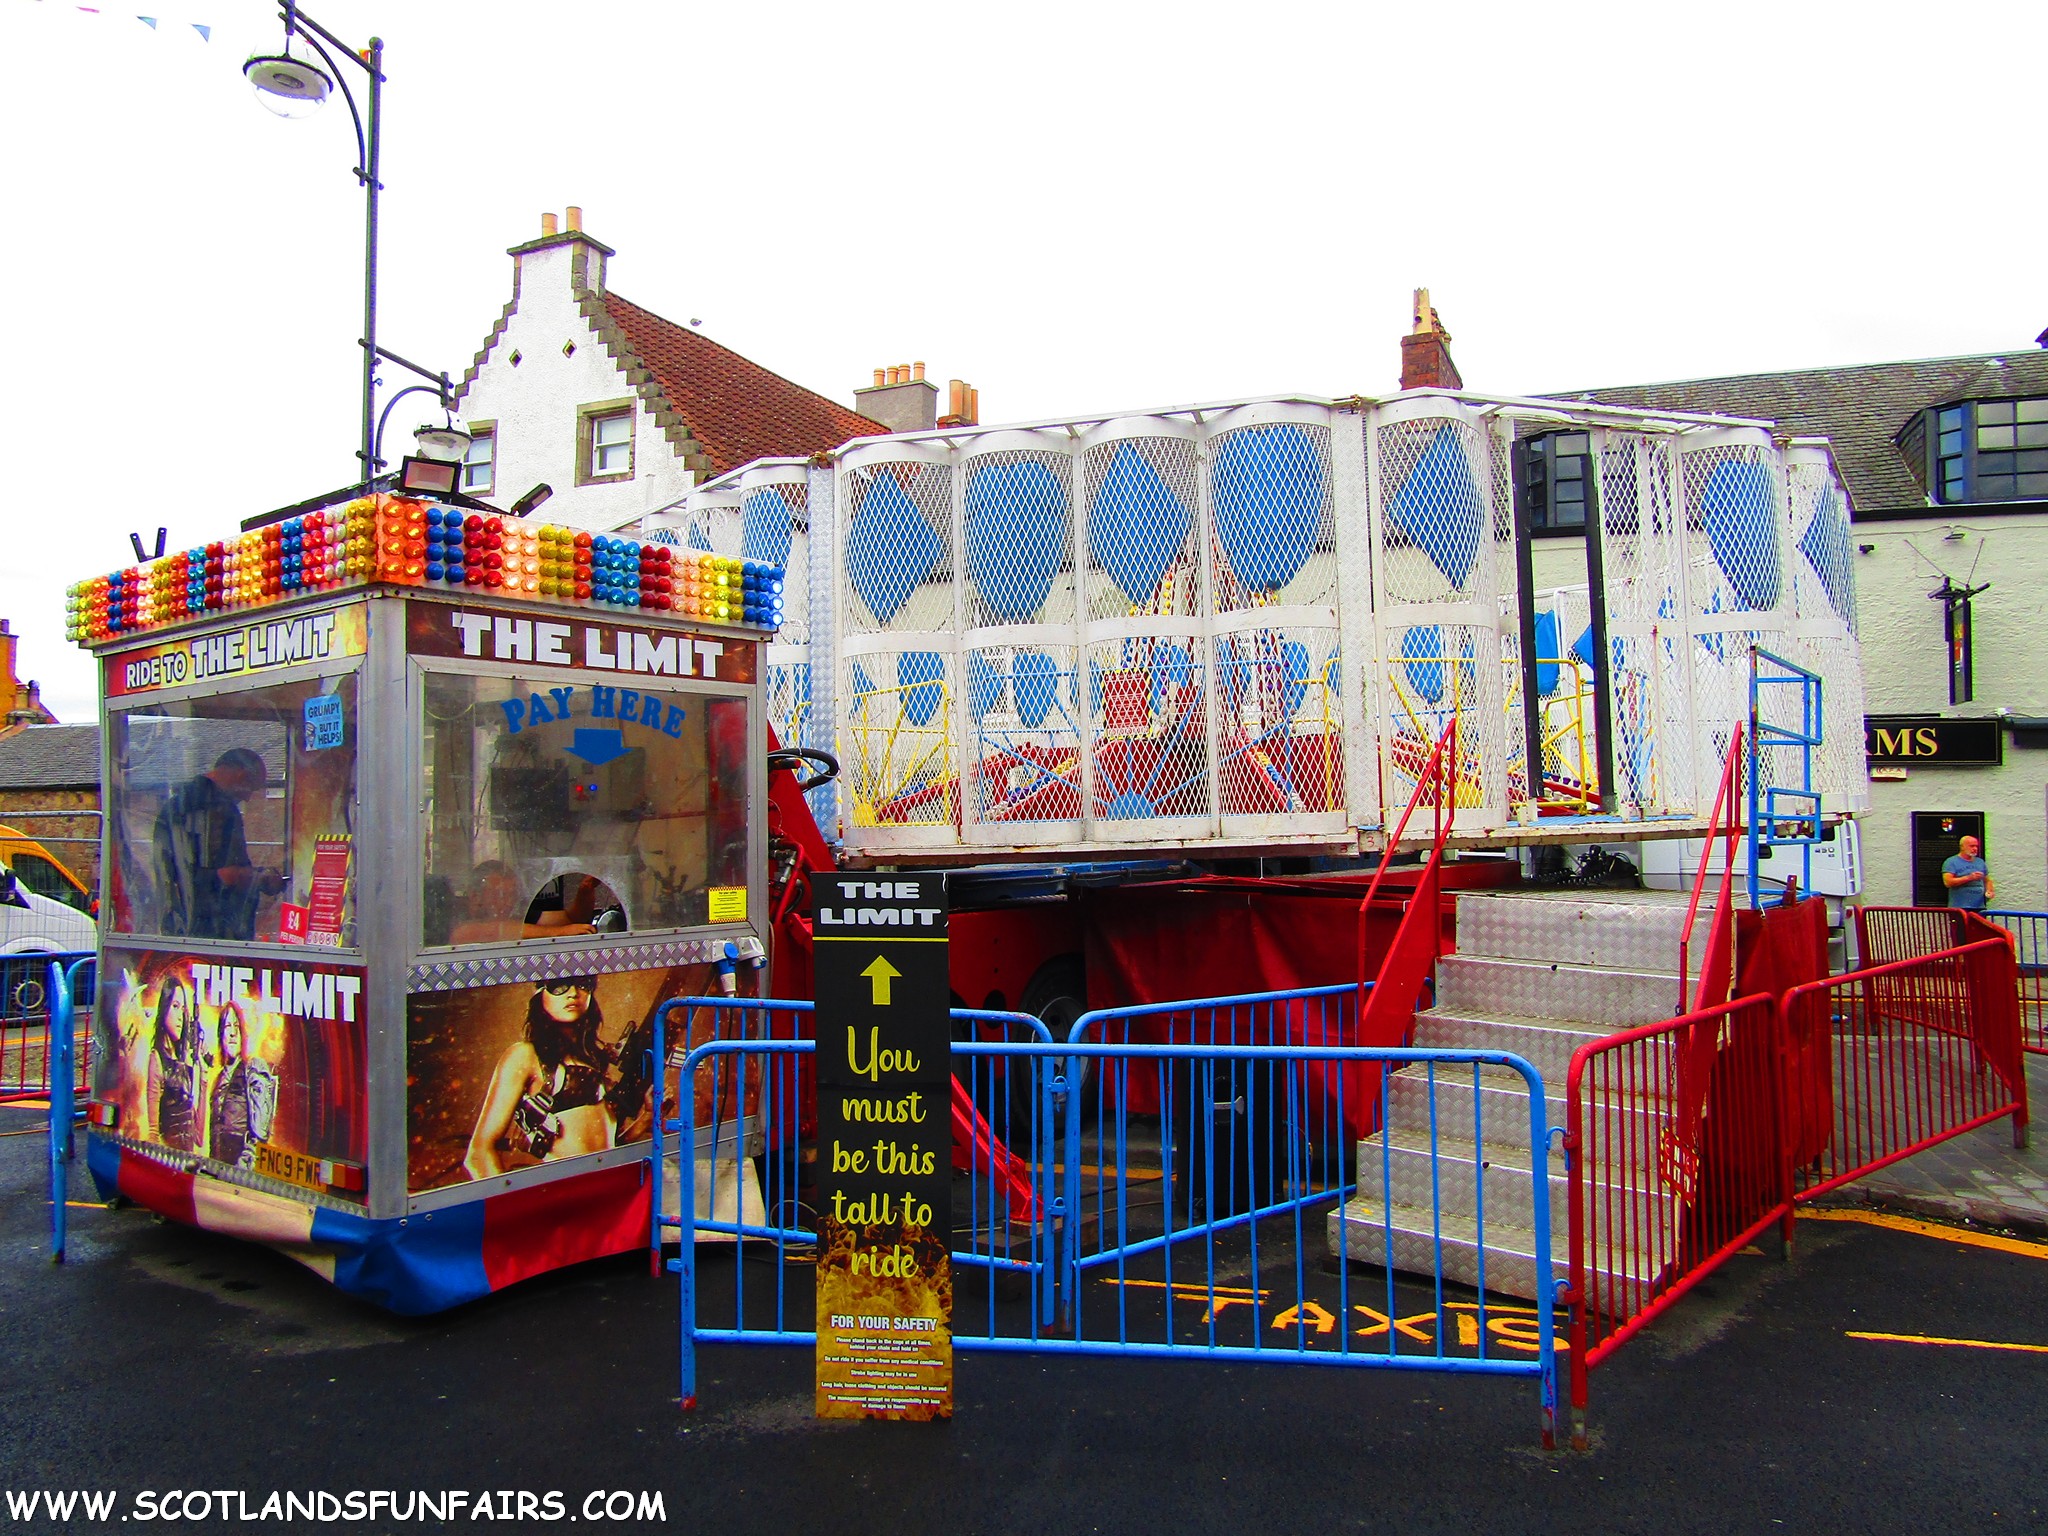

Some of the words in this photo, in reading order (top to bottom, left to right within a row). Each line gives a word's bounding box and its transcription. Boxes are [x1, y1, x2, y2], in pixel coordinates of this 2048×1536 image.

[126, 657, 161, 689] RIDE
[163, 651, 188, 683] TO
[191, 631, 244, 677] THE
[249, 612, 335, 668] LIMIT
[452, 611, 572, 665] THE
[585, 627, 724, 677] LIMIT
[308, 702, 340, 718] GRUMPY
[319, 722, 332, 732] BUT
[333, 721, 339, 731] IT
[501, 686, 575, 734] PAY
[591, 685, 687, 738] HERE
[317, 731, 342, 745] HELPS!
[837, 881, 920, 899] THE
[287, 910, 300, 931] £4
[820, 908, 941, 926] LIMIT
[191, 963, 254, 1012] THE
[261, 968, 361, 1022] LIMIT
[847, 1025, 921, 1082] You
[842, 1091, 927, 1123] must
[832, 1139, 870, 1173] be
[872, 1139, 935, 1175] this
[831, 1189, 897, 1225] tall
[900, 1191, 933, 1227] to
[851, 1244, 919, 1278] ride
[831, 1315, 854, 1328] FOR
[858, 1315, 890, 1330] YOUR
[893, 1317, 938, 1331] SAFETY
[1173, 1293, 1571, 1353] TAXIS
